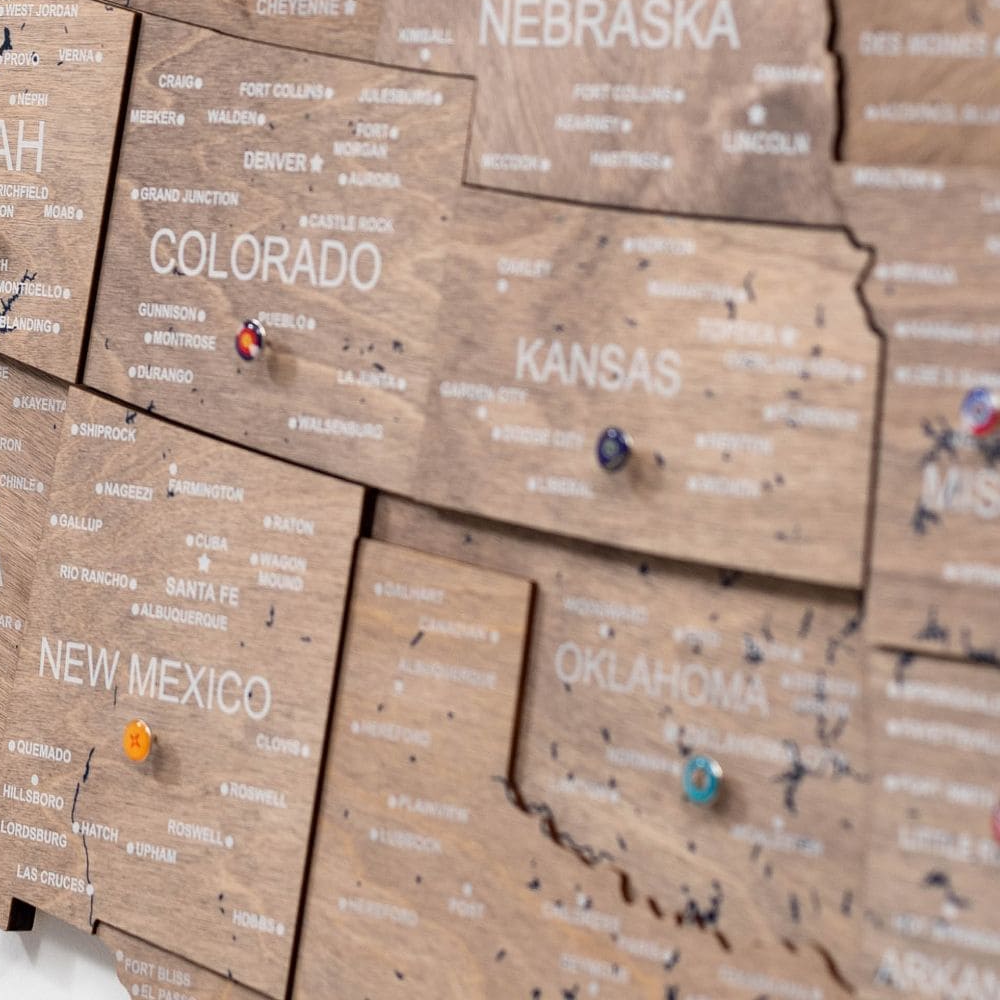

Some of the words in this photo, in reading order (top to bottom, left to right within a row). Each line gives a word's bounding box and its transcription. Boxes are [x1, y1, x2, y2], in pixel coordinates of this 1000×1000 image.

[6, 4, 34, 16] WEST
[36, 4, 78, 17] JORDAN
[4, 54, 40, 66] PROVO
[159, 74, 194, 89] CRAIG
[18, 91, 49, 106] NEPHI
[131, 110, 177, 125] MEEKER
[208, 110, 257, 125] WALDEN
[244, 151, 306, 172] DENVER
[140, 187, 180, 202] GRAND
[182, 189, 239, 206] JUNCTION
[44, 205, 74, 219] MOAB
[150, 227, 382, 291] COLORADO
[139, 303, 196, 321] GUNNISON
[0, 316, 51, 333] BLANDING
[153, 332, 216, 350] MONTROSE
[137, 365, 193, 384] DURANGO
[514, 336, 684, 398] KANSAS
[80, 424, 136, 442] SHIPROCK
[0, 474, 36, 490] CHINLE
[104, 482, 153, 501] NAGEEZI
[59, 514, 103, 532] GALLUP
[60, 565, 78, 580] RIO
[81, 568, 128, 589] RANCHO
[166, 577, 215, 601] SANTA
[219, 585, 239, 606] FE
[140, 598, 228, 631] ALBUQUERQUE
[38, 635, 121, 692] NEW
[128, 653, 272, 720] MEXICO
[552, 640, 771, 717] OKLAHOMA
[16, 740, 72, 763] QUEMADO
[3, 784, 64, 810] HILLSBORO
[0, 821, 68, 848] LORDSBURG
[80, 821, 119, 843] HATCH
[168, 819, 224, 846] ROSWELL
[135, 842, 177, 864] UPHAM
[17, 865, 38, 881] LAS
[40, 870, 84, 893] CRUCES
[124, 960, 154, 977] FORT
[158, 968, 192, 988] BLISS
